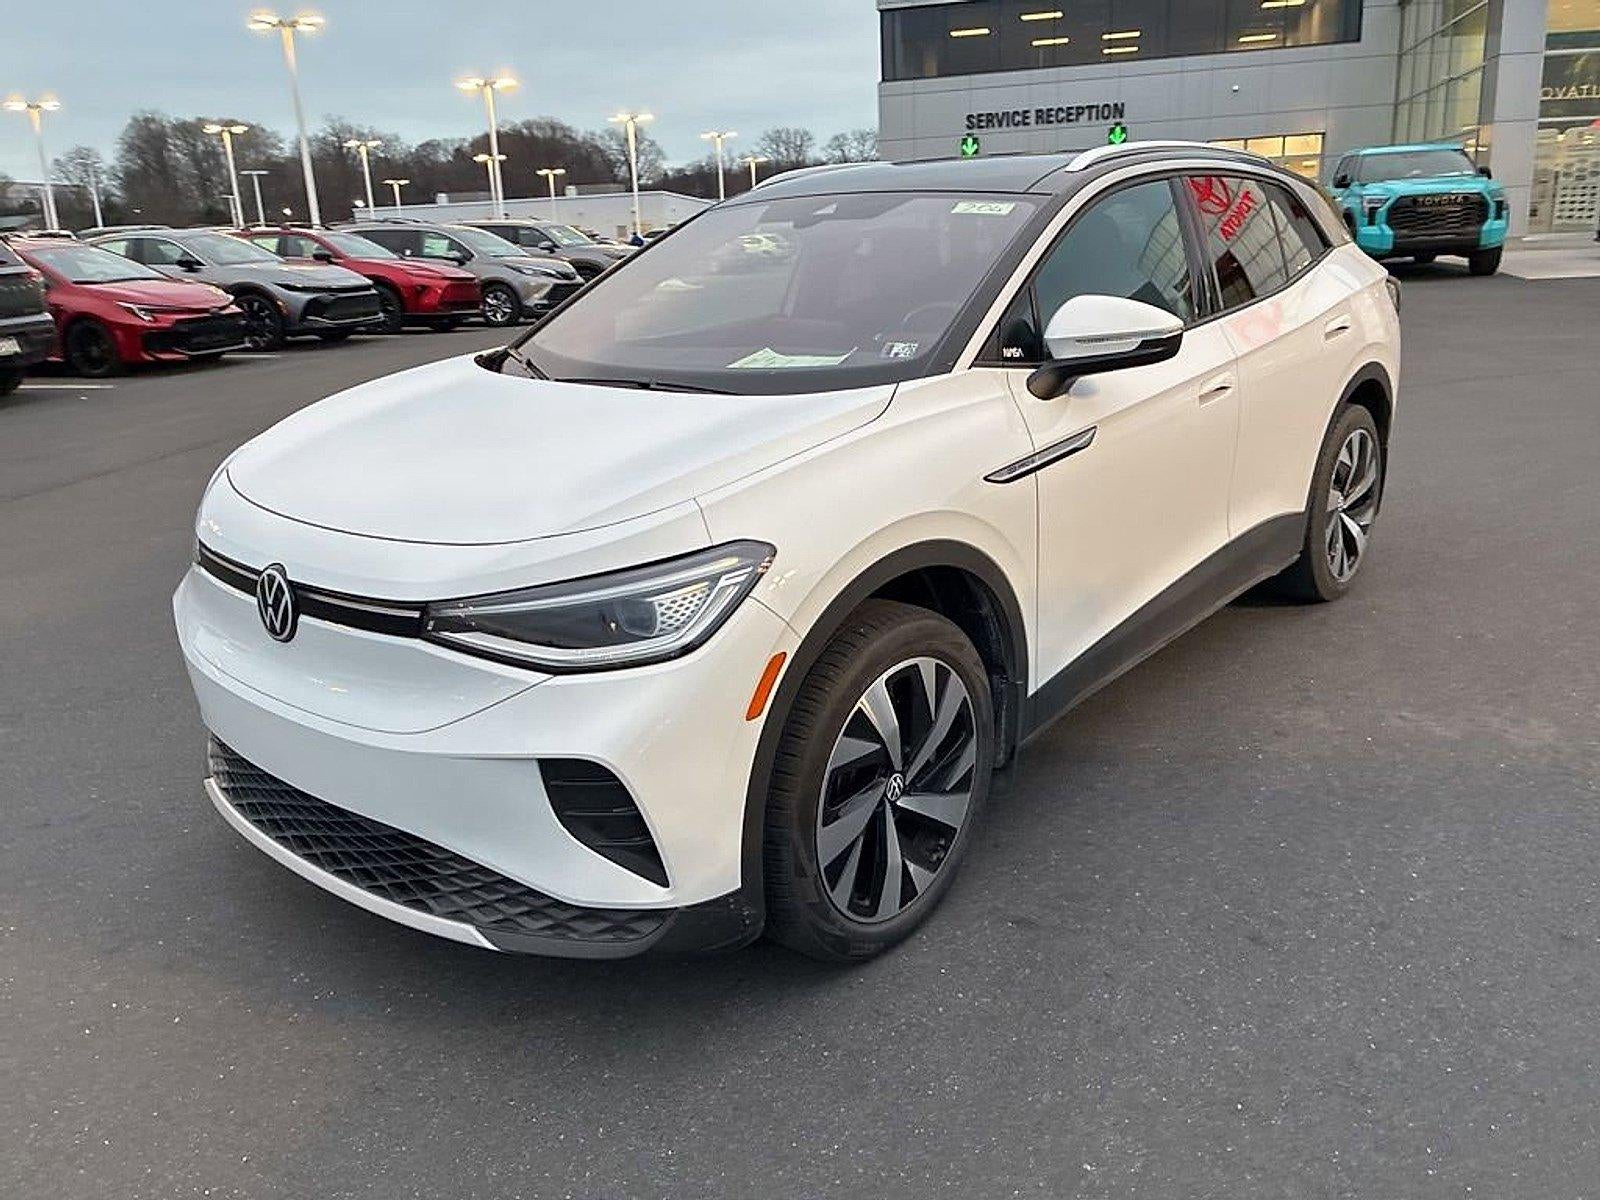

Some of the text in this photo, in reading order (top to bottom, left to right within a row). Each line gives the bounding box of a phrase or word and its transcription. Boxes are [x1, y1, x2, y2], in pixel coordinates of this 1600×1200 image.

[965, 102, 1125, 130] SERVICE RECEPTION
[1414, 195, 1464, 207] TOYOTA
